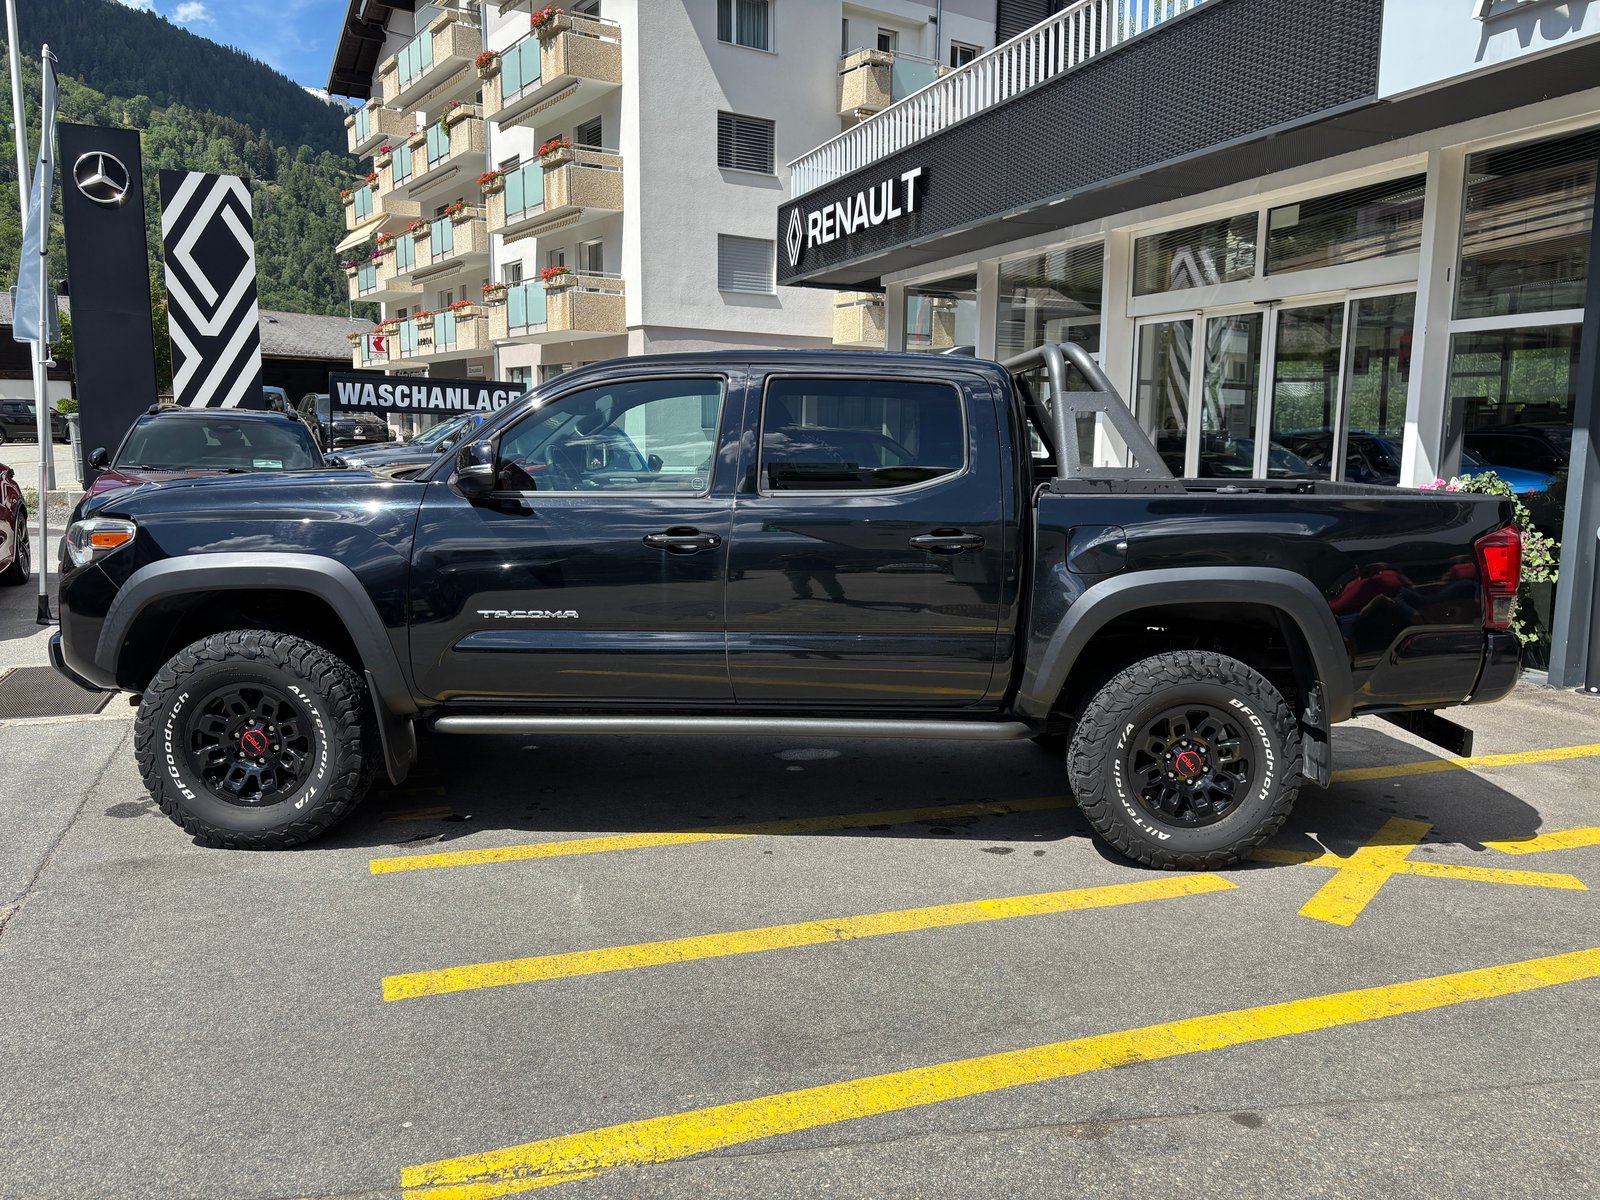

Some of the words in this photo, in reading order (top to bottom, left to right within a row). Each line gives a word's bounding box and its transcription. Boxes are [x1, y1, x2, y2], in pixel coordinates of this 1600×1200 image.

[807, 167, 922, 249] RENAULT
[477, 610, 579, 619] TACOMA
[165, 692, 197, 800] BFGoodrich
[287, 685, 328, 780] All-Terrain
[1116, 722, 1135, 750] T/A
[1228, 698, 1275, 801] BFGoodrich
[294, 786, 318, 810] T/A
[1112, 759, 1172, 841] All-Terrain
